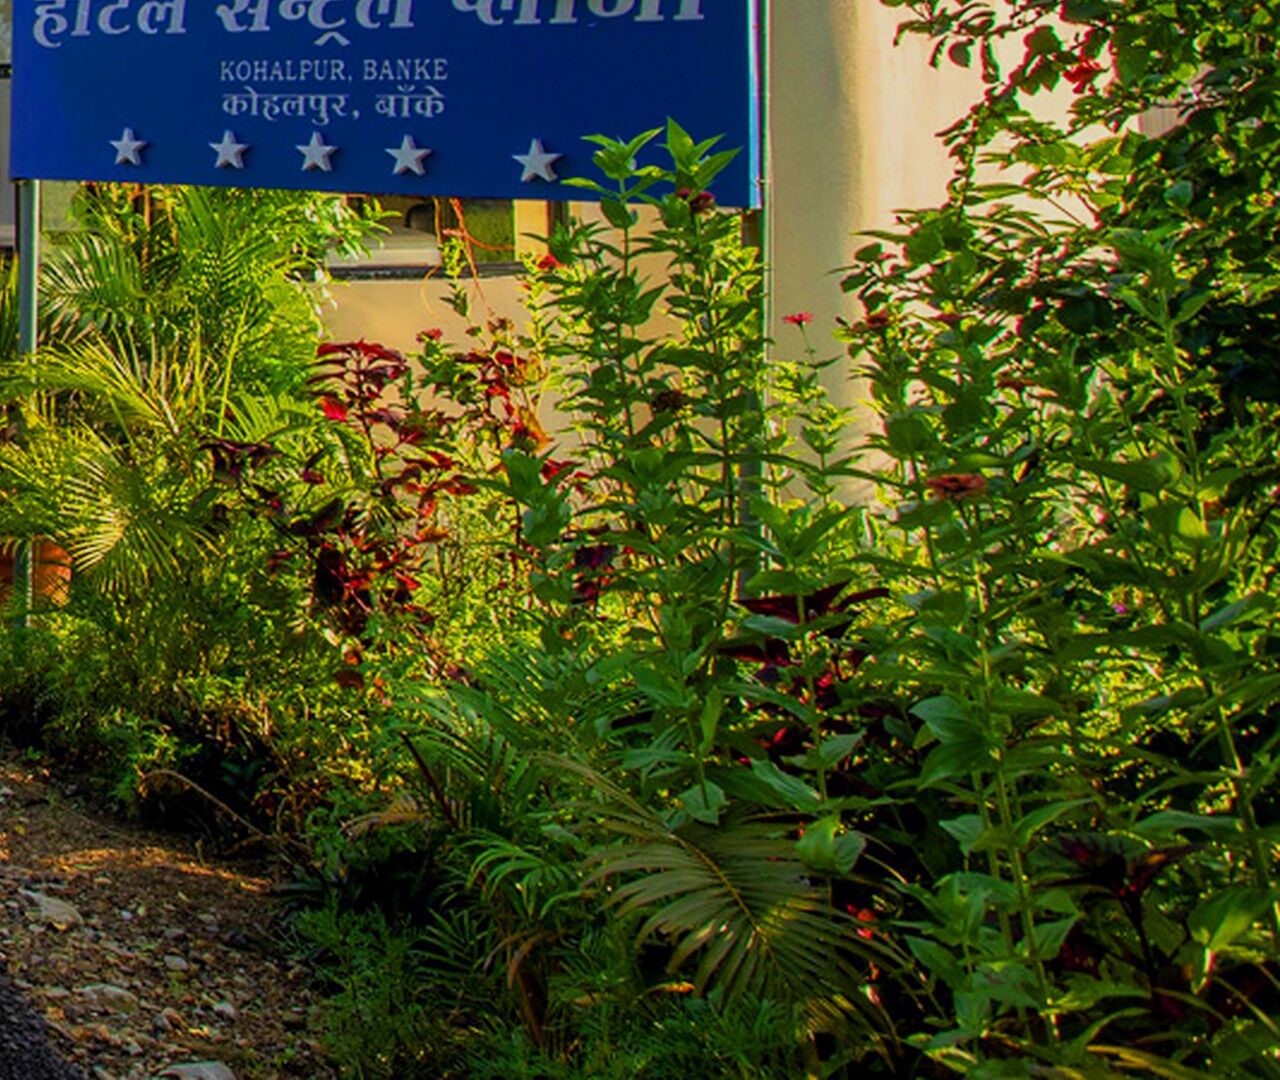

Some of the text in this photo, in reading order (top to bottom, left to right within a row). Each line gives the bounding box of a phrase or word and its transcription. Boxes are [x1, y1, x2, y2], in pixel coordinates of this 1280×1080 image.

[219, 58, 449, 83] KOHALPUR, BANKE
[221, 84, 445, 126] कोहलपुर, बाँके
